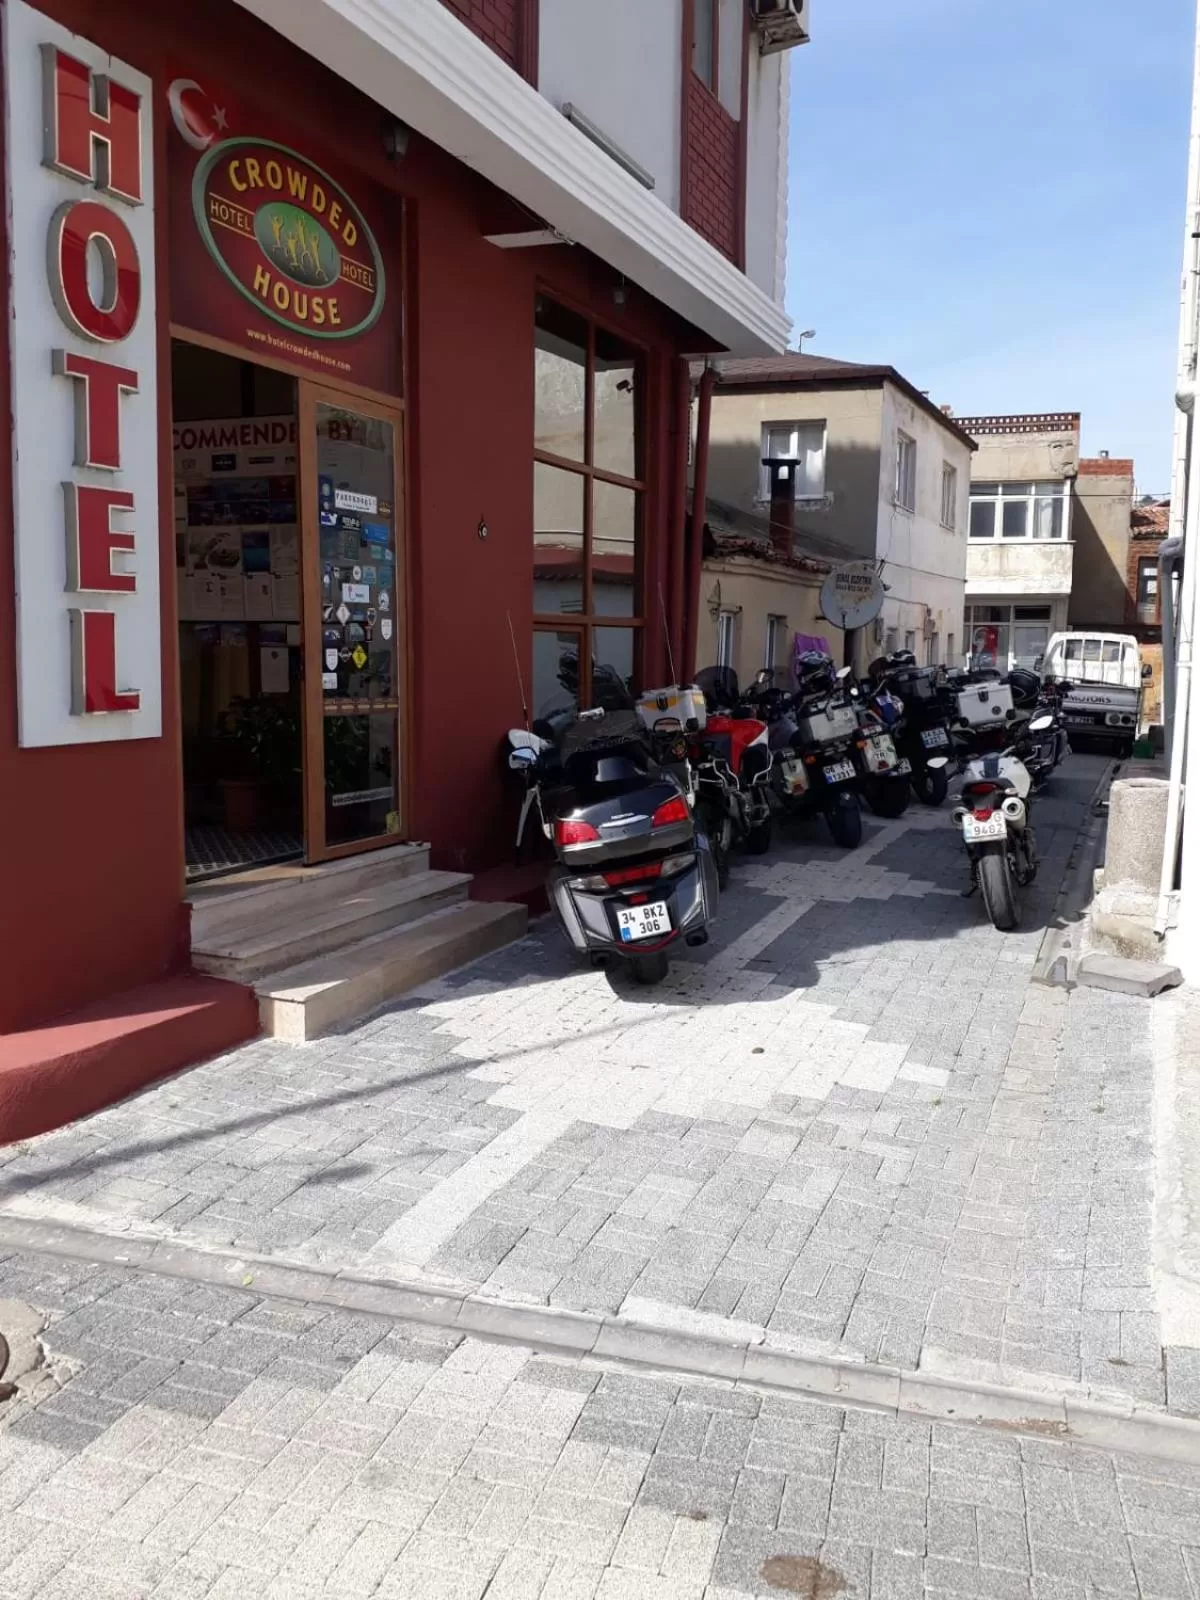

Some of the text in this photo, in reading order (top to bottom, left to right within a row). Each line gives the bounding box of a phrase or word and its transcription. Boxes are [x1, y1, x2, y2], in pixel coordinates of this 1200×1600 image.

[209, 201, 250, 231] HOTEL
[228, 157, 357, 247] CROWDED
[342, 262, 374, 287] HOTEL
[253, 264, 341, 324] HOUSE
[40, 42, 142, 718] HOTEL
[621, 904, 664, 924] 34 BKZ
[639, 919, 661, 934] 306
